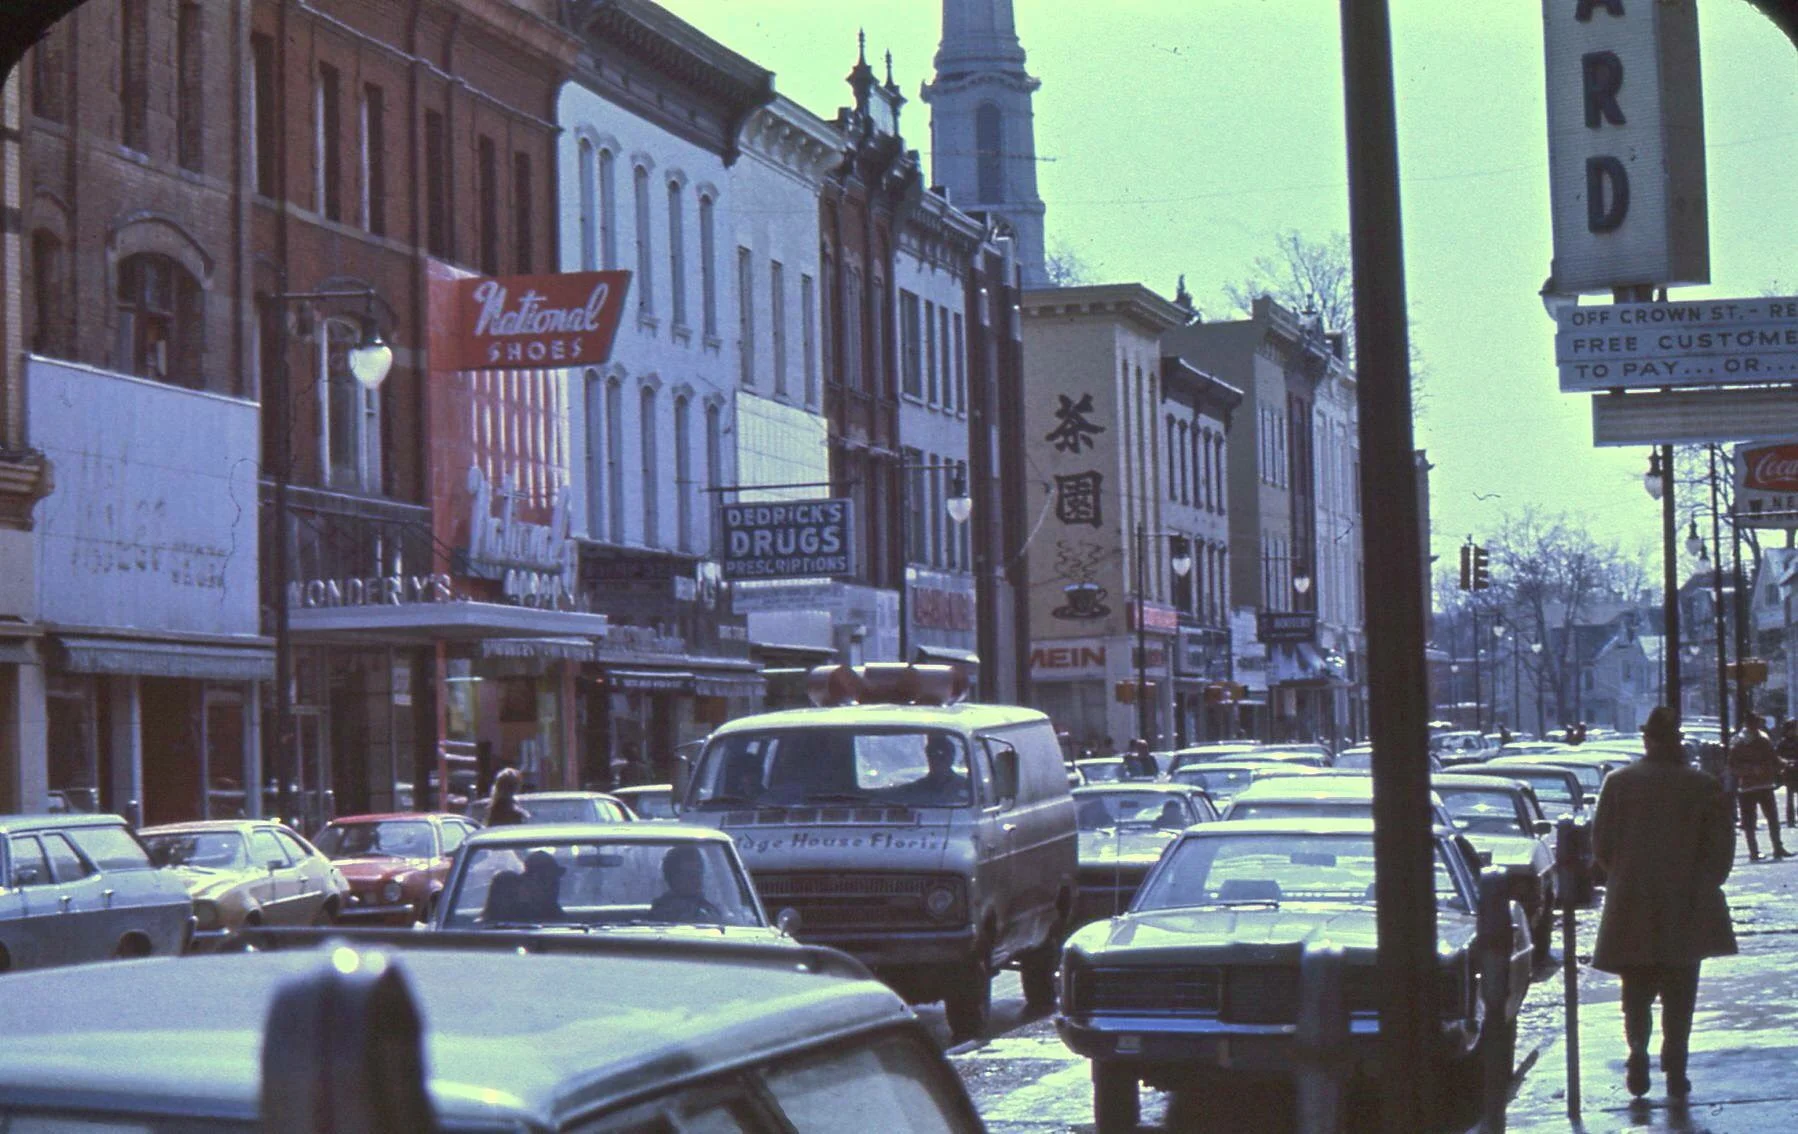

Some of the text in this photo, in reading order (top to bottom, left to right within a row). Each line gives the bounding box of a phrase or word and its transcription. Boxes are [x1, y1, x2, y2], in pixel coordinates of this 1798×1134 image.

[1574, 0, 1631, 235] RD
[473, 281, 609, 336] National
[1572, 311, 1611, 326] OFF
[1620, 306, 1701, 324] CROWN
[1711, 304, 1743, 320] ST.
[1769, 302, 1798, 318] RE
[488, 337, 583, 362] SHOES
[1573, 329, 1798, 353] FREE CUSTOME
[1574, 363, 1608, 379] TO
[727, 503, 842, 526] DEDRICK'S
[731, 525, 841, 557] DRUGS
[726, 556, 847, 575] PRESCRIPTIONS
[792, 833, 863, 849] House
